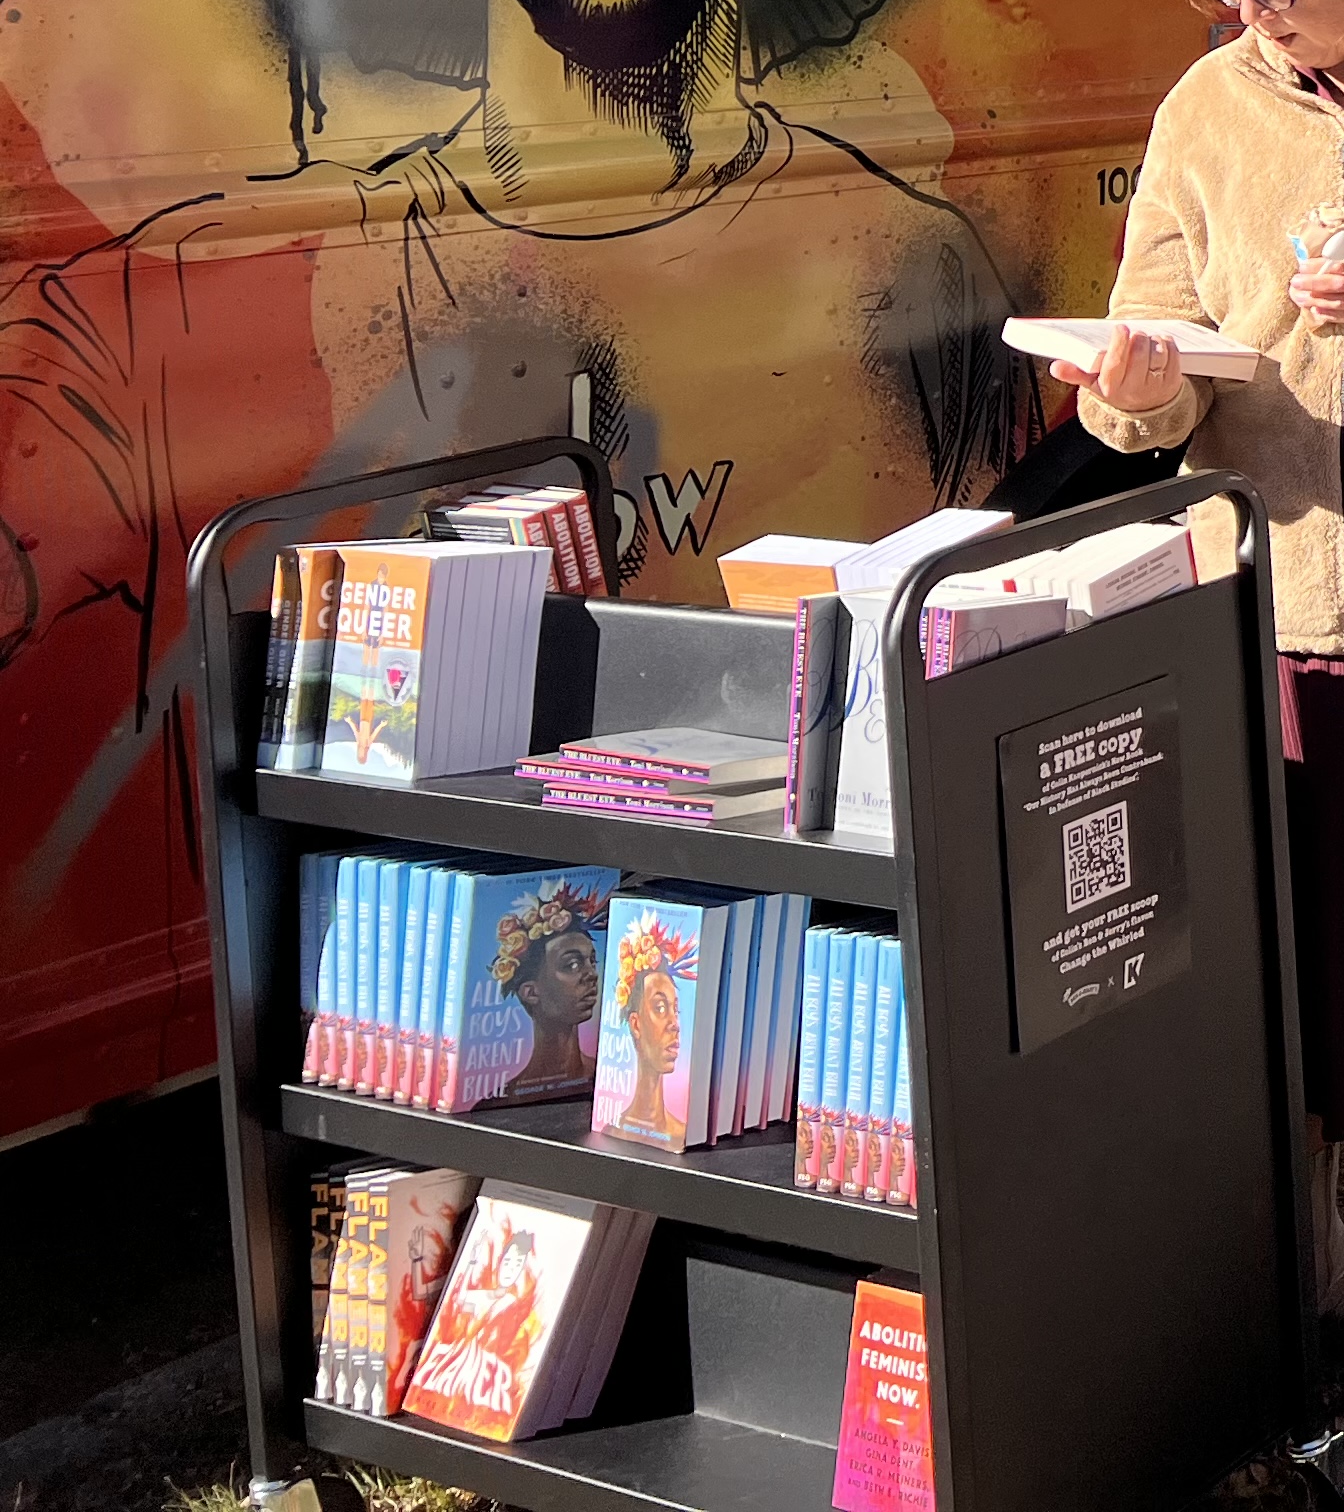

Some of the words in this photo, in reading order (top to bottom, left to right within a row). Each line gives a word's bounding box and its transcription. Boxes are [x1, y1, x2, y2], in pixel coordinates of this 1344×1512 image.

[552, 512, 581, 589] ABOLITION
[573, 504, 602, 580] ABOLITION
[341, 580, 416, 611] GENDER
[337, 607, 413, 641] QUEER
[1038, 740, 1061, 755] Scan
[1062, 731, 1085, 747] here
[1085, 725, 1096, 738] to
[1096, 707, 1143, 733] download
[564, 750, 578, 760] THE
[630, 760, 645, 769] Toni
[1053, 740, 1096, 774] FREE
[1098, 727, 1143, 756] copy
[521, 764, 536, 774] THE
[589, 773, 605, 783] Toni
[550, 789, 565, 799] THE
[625, 797, 642, 807] Toni
[861, 791, 891, 810] Morr
[1043, 934, 1063, 952] and
[1064, 925, 1080, 945] get
[1081, 914, 1107, 935] your
[1107, 903, 1130, 922] FREE
[1059, 953, 1091, 974] Change
[1092, 944, 1108, 960] the
[1107, 926, 1145, 951] Whirled
[471, 979, 502, 1010] ALL
[469, 1005, 522, 1040] BOYS
[602, 1000, 622, 1031] ALL
[601, 1034, 633, 1064] BOYS
[462, 1070, 510, 1103] BLUE
[595, 1097, 621, 1129] BLUE
[347, 1191, 370, 1349] FLAMER
[368, 1193, 389, 1354] FLAMER
[412, 1334, 513, 1416] FLAMER
[861, 1348, 928, 1382] FEMINIS
[876, 1381, 920, 1409] NOW.
[854, 1428, 888, 1447] ANGELA
[850, 1459, 873, 1476] ERICA
[865, 1447, 888, 1464] GINA
[864, 1479, 886, 1497] BETH
[898, 1491, 929, 1509] RICHIE
